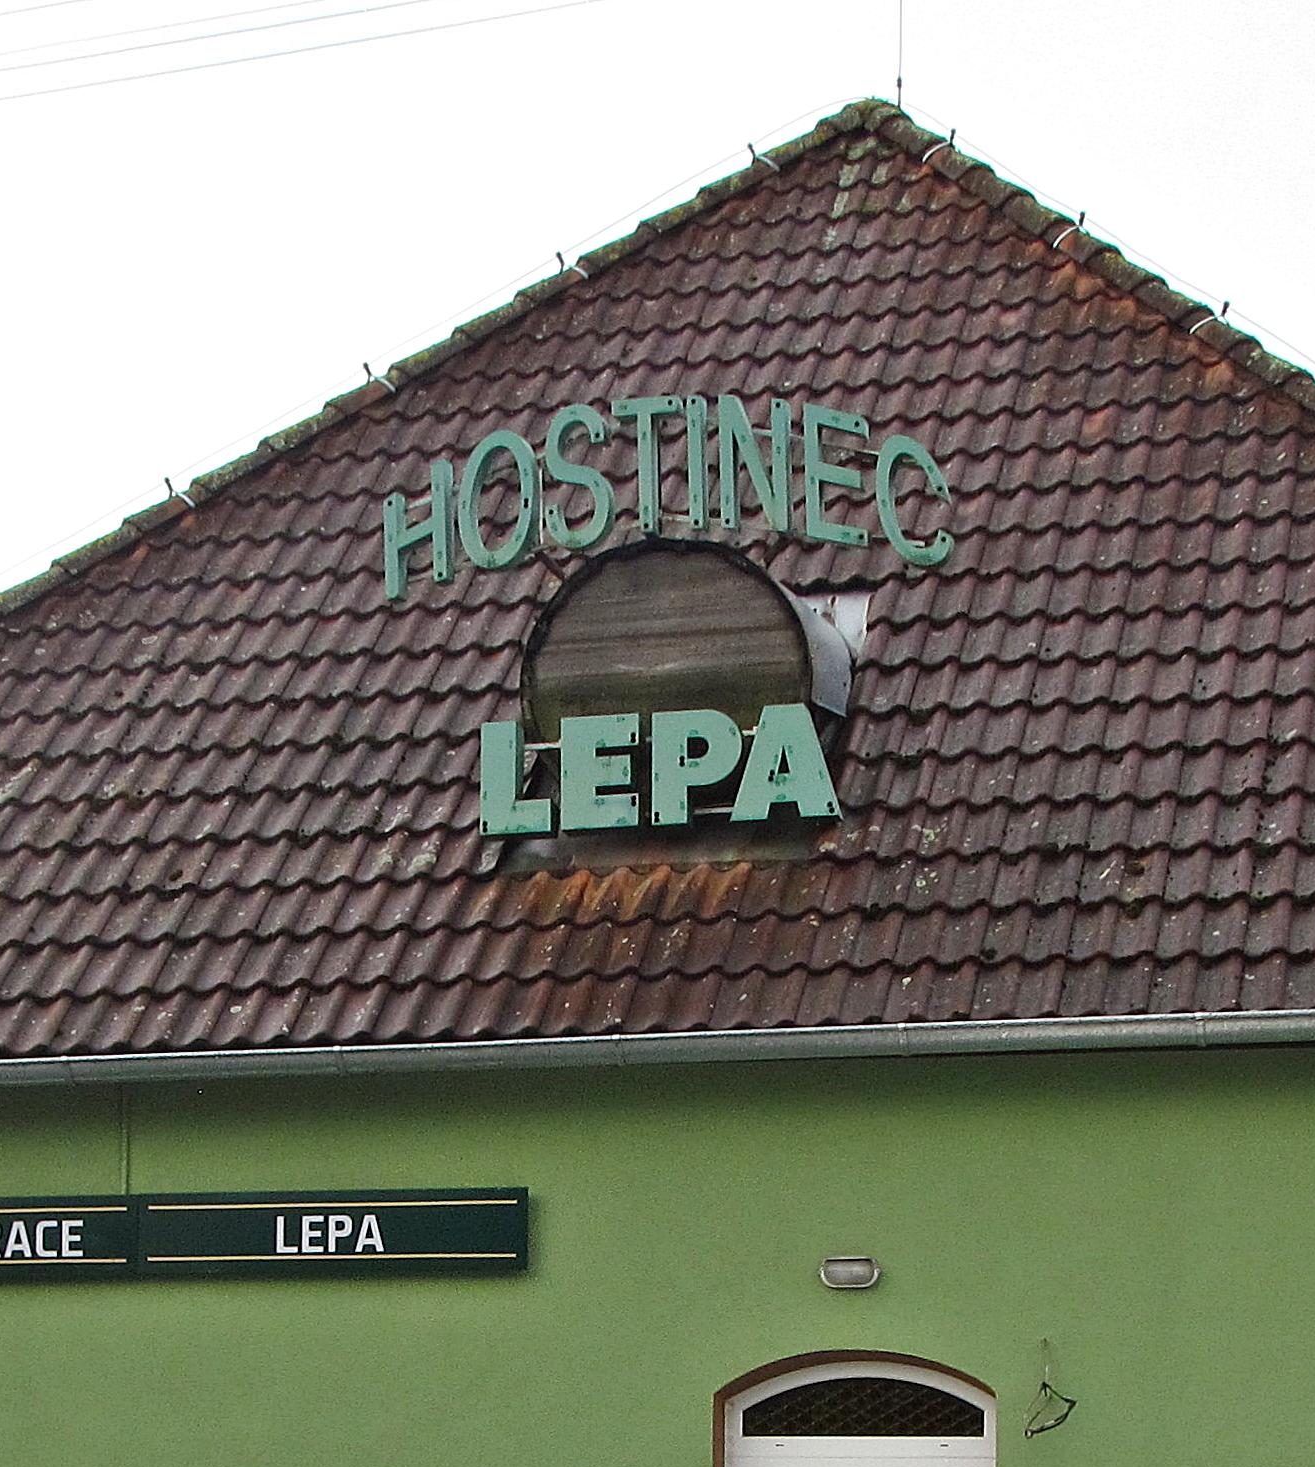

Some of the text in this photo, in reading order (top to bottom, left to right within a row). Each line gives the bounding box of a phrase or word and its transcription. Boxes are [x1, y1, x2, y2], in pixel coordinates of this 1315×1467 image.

[383, 395, 954, 600] HOSTINEC
[481, 703, 843, 836] LEPA
[276, 1214, 385, 1254] LEPA
